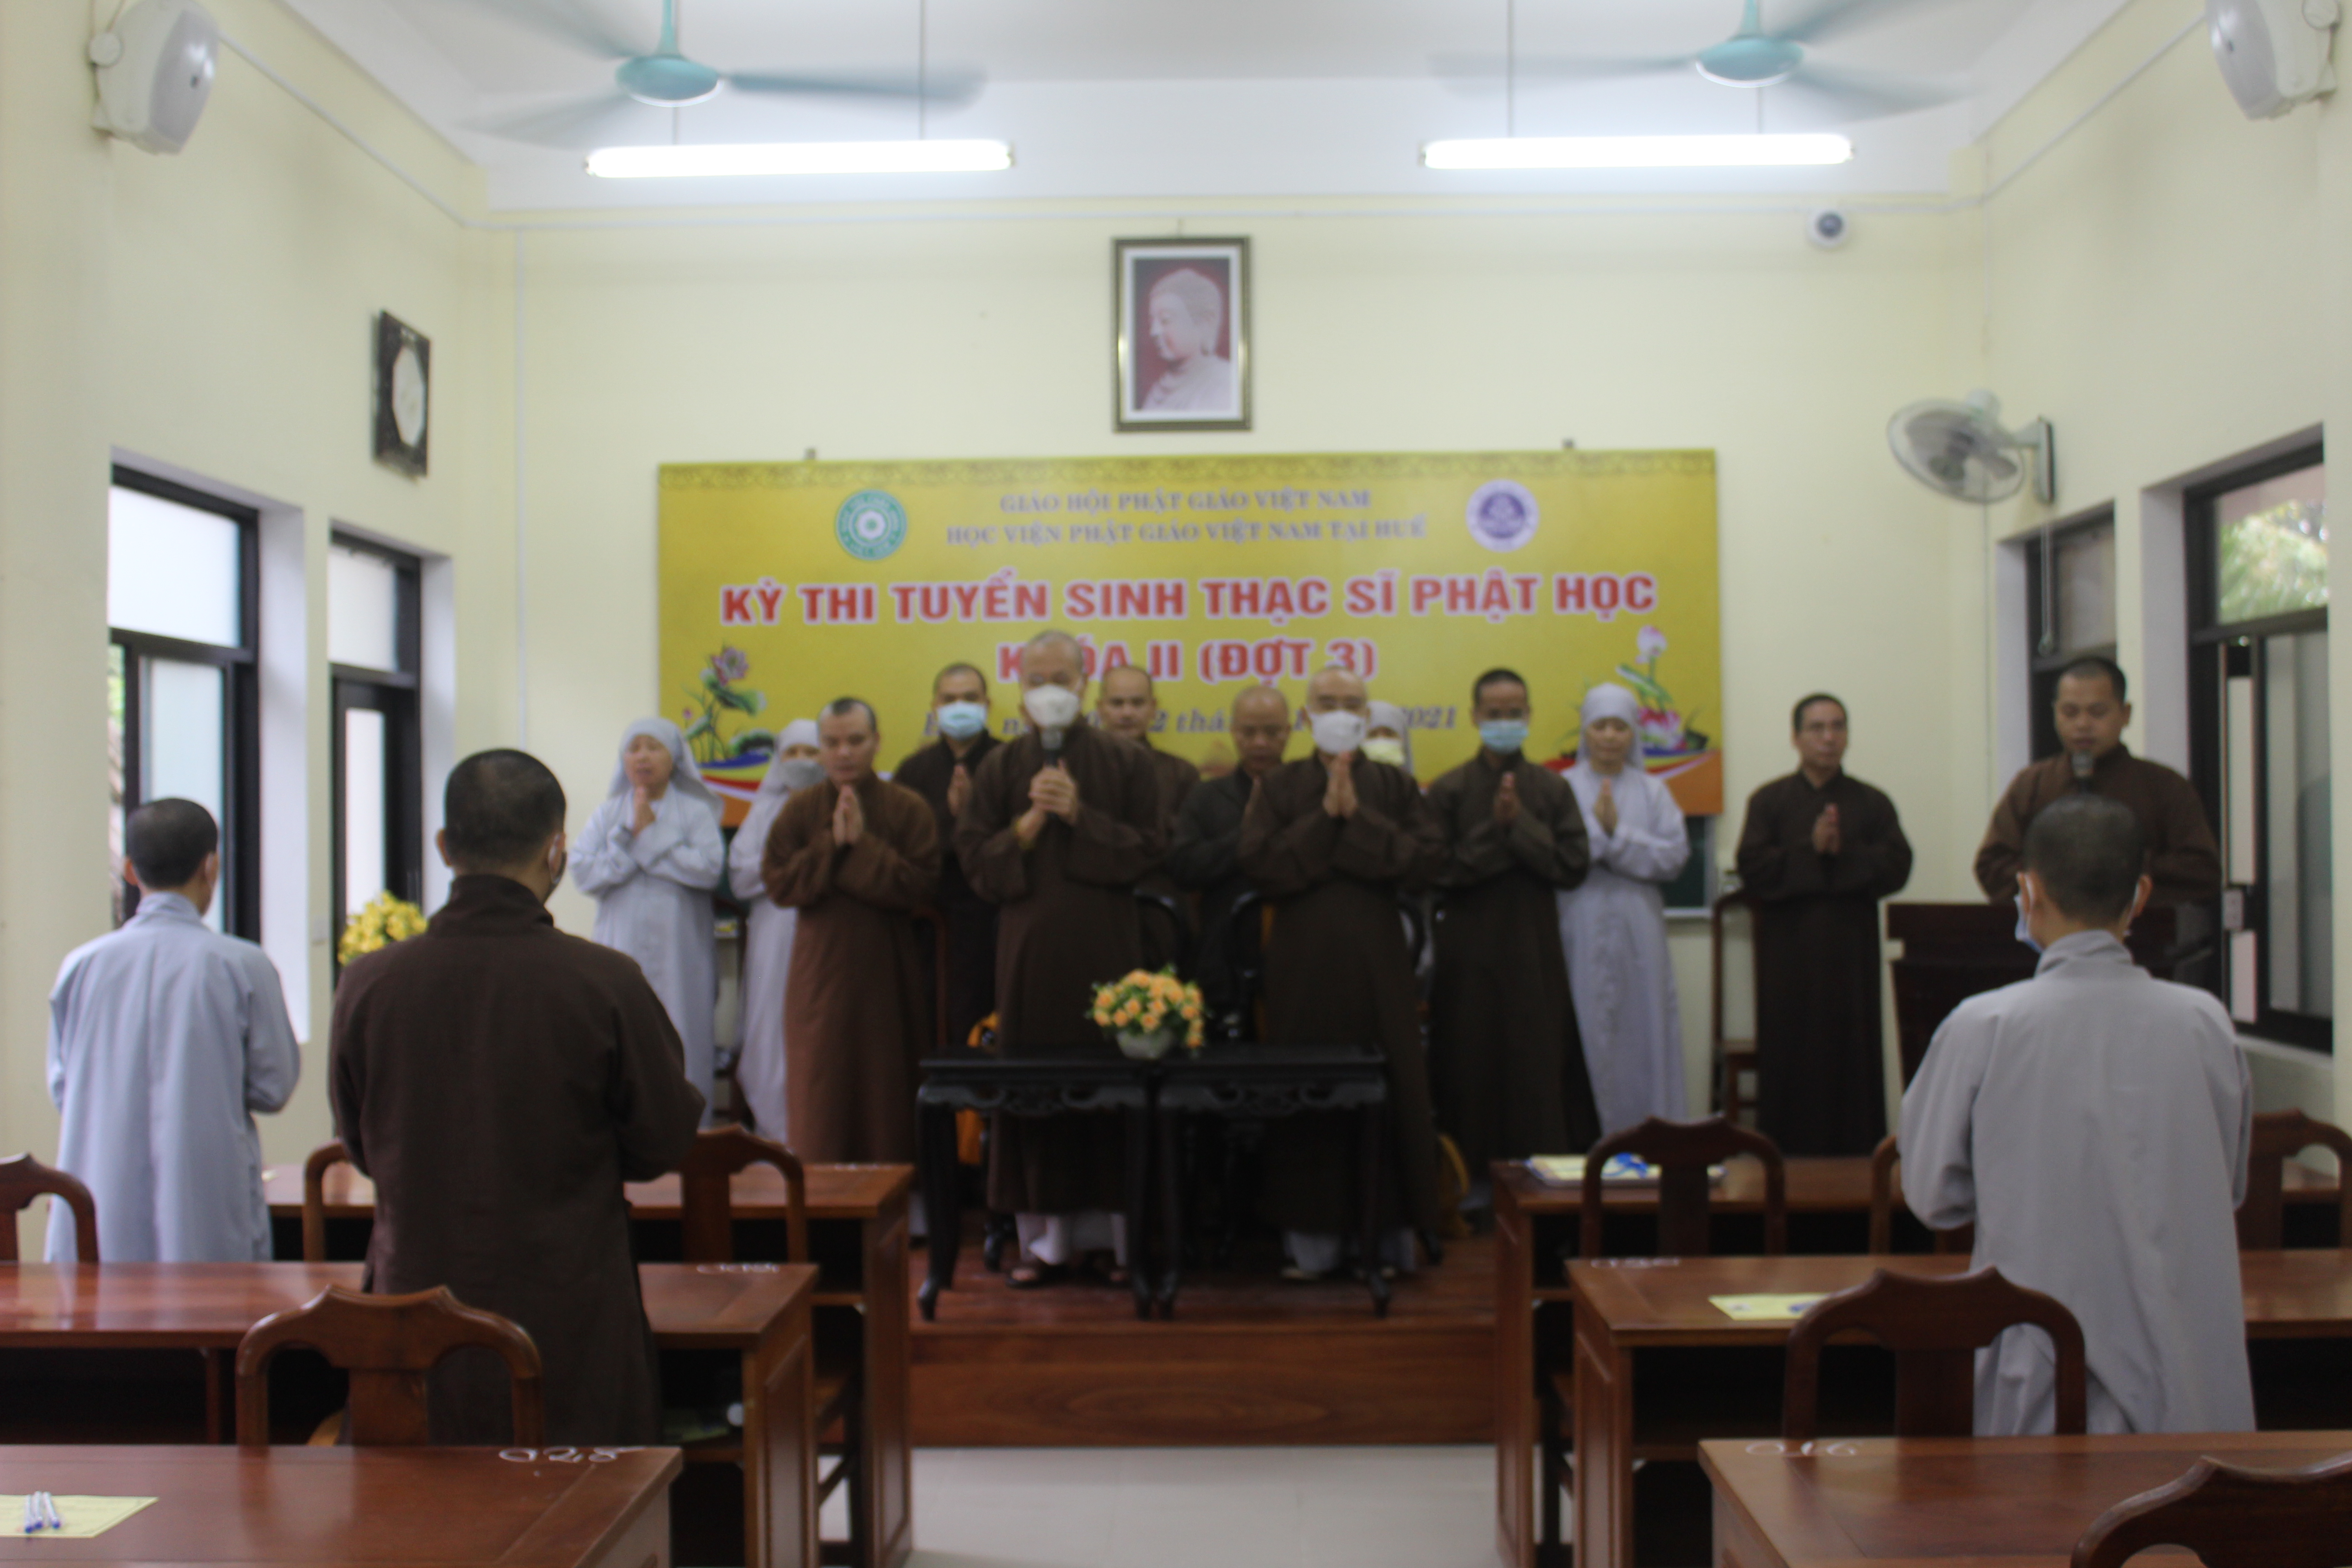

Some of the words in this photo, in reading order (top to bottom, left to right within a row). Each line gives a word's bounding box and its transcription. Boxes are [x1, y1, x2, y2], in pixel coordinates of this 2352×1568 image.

[1188, 487, 1249, 510] GIÁO
[1318, 490, 1372, 509] NAM
[946, 525, 998, 549] HỌC
[1139, 519, 1199, 543] GIÁO
[1267, 521, 1321, 540] NAM
[798, 586, 875, 623] THI
[890, 568, 1049, 621] TUYỂN
[1065, 581, 1185, 619] SINH
[1200, 578, 1328, 625] THẠC
[1346, 570, 1399, 615] SĨ
[1412, 568, 1540, 622] PHẬT
[1555, 574, 1655, 621] HỌC
[1150, 642, 1181, 679] II
[1200, 637, 1313, 686] (ĐỢT
[1328, 641, 1376, 679] 3)
